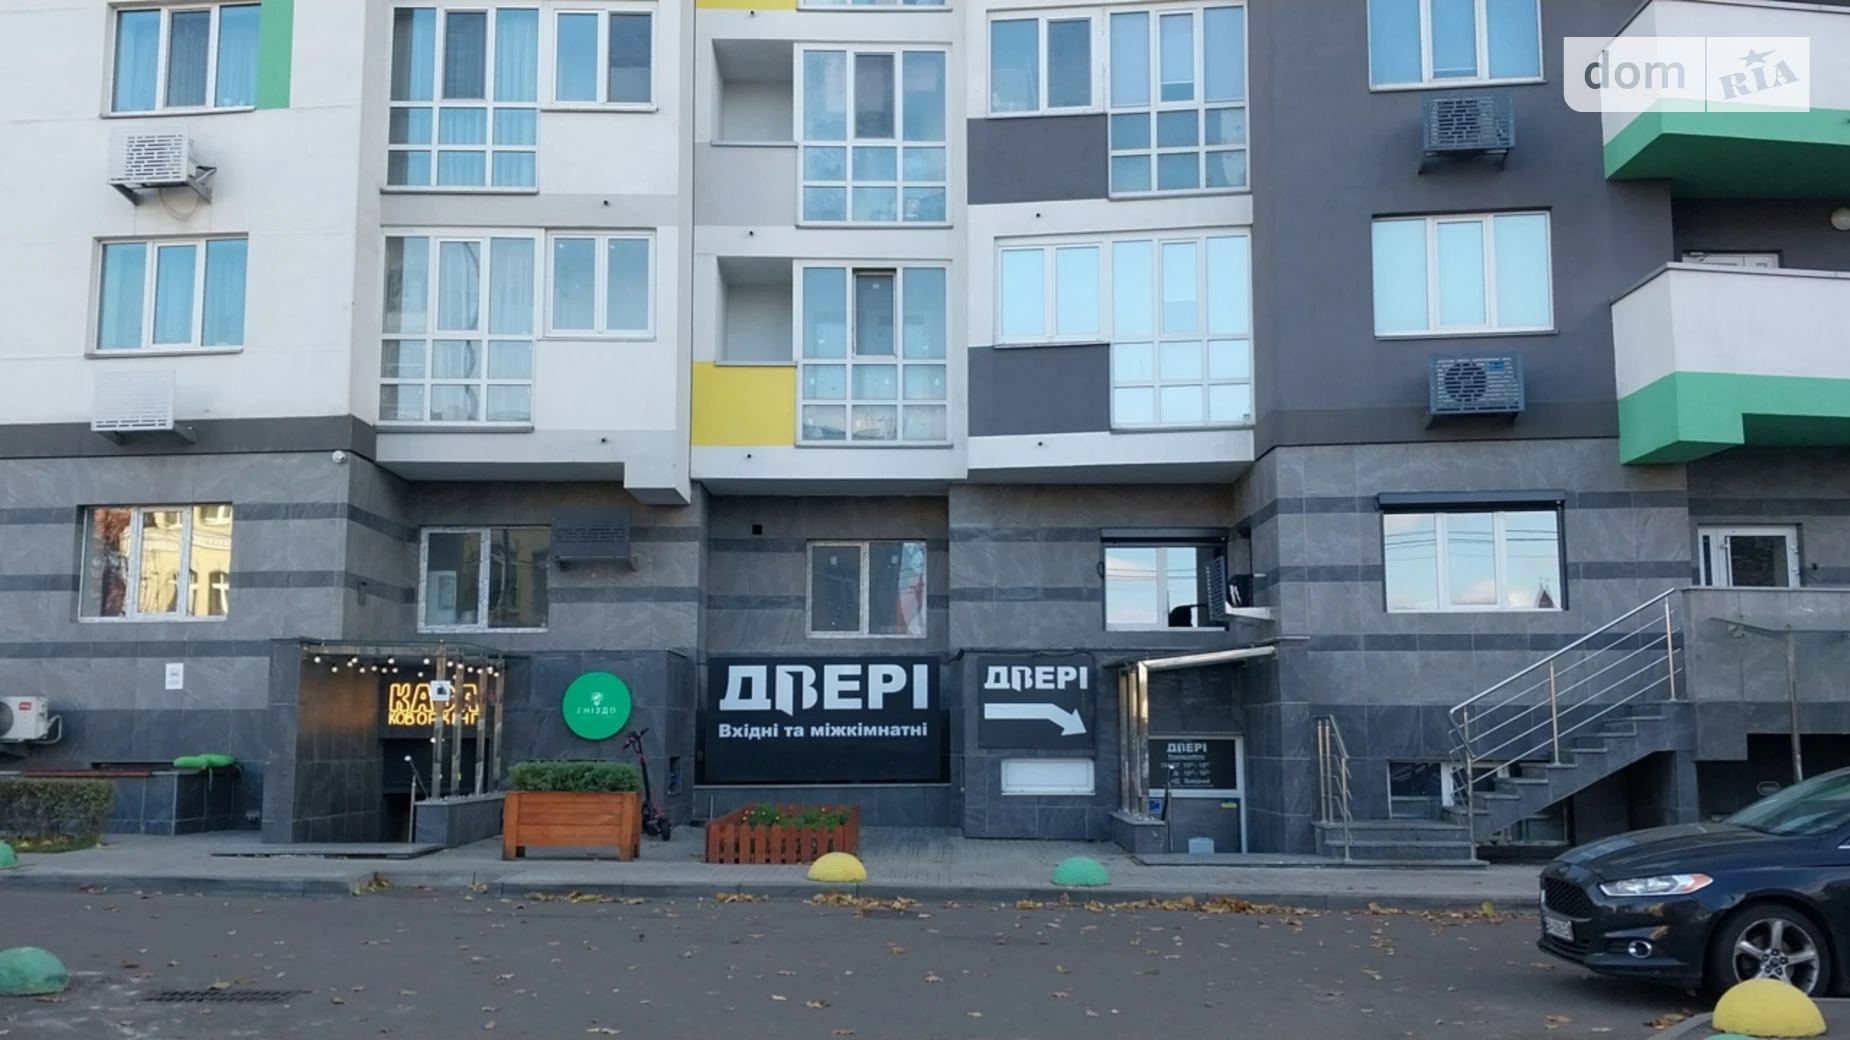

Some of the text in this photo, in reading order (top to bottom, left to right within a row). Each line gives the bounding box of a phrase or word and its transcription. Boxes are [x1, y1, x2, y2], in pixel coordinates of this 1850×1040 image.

[984, 666, 1088, 692] ДВЕРІ
[719, 664, 928, 717] ДВЕРІ
[576, 706, 617, 715] ГНІЗДО
[718, 722, 928, 740] Вхідні та міжкімнатні
[1166, 742, 1208, 753] ДВЕРІ
